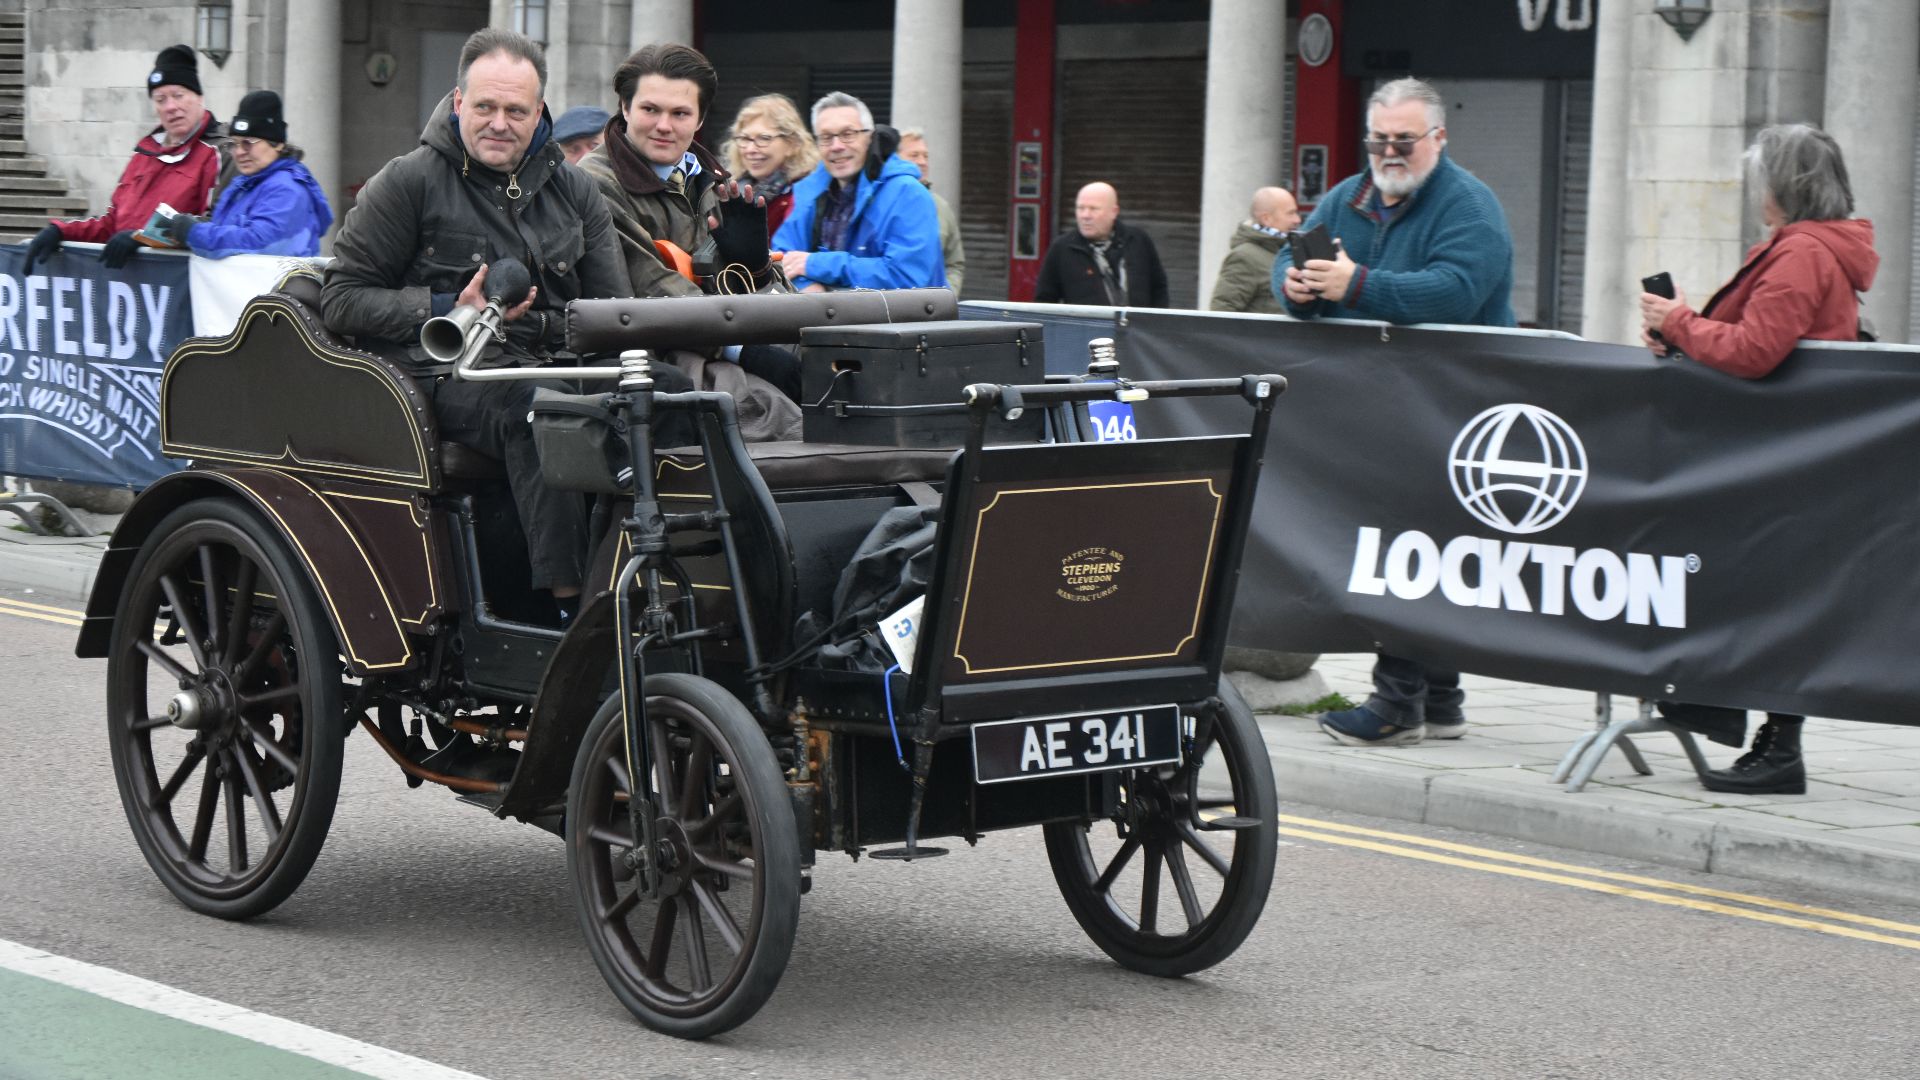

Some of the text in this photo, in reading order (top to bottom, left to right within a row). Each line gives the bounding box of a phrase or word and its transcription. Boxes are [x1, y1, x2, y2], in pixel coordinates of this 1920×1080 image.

[22, 355, 103, 398] SINGLE
[105, 384, 156, 439] MALT
[28, 386, 118, 440] WHISKY
[1061, 547, 1125, 565] PATENTEE AND
[1062, 562, 1122, 576] STEPHENS
[1066, 574, 1113, 585] CLEVEDON
[1056, 584, 1119, 602] MANUFACTURER
[1021, 713, 1147, 772] AE 341
